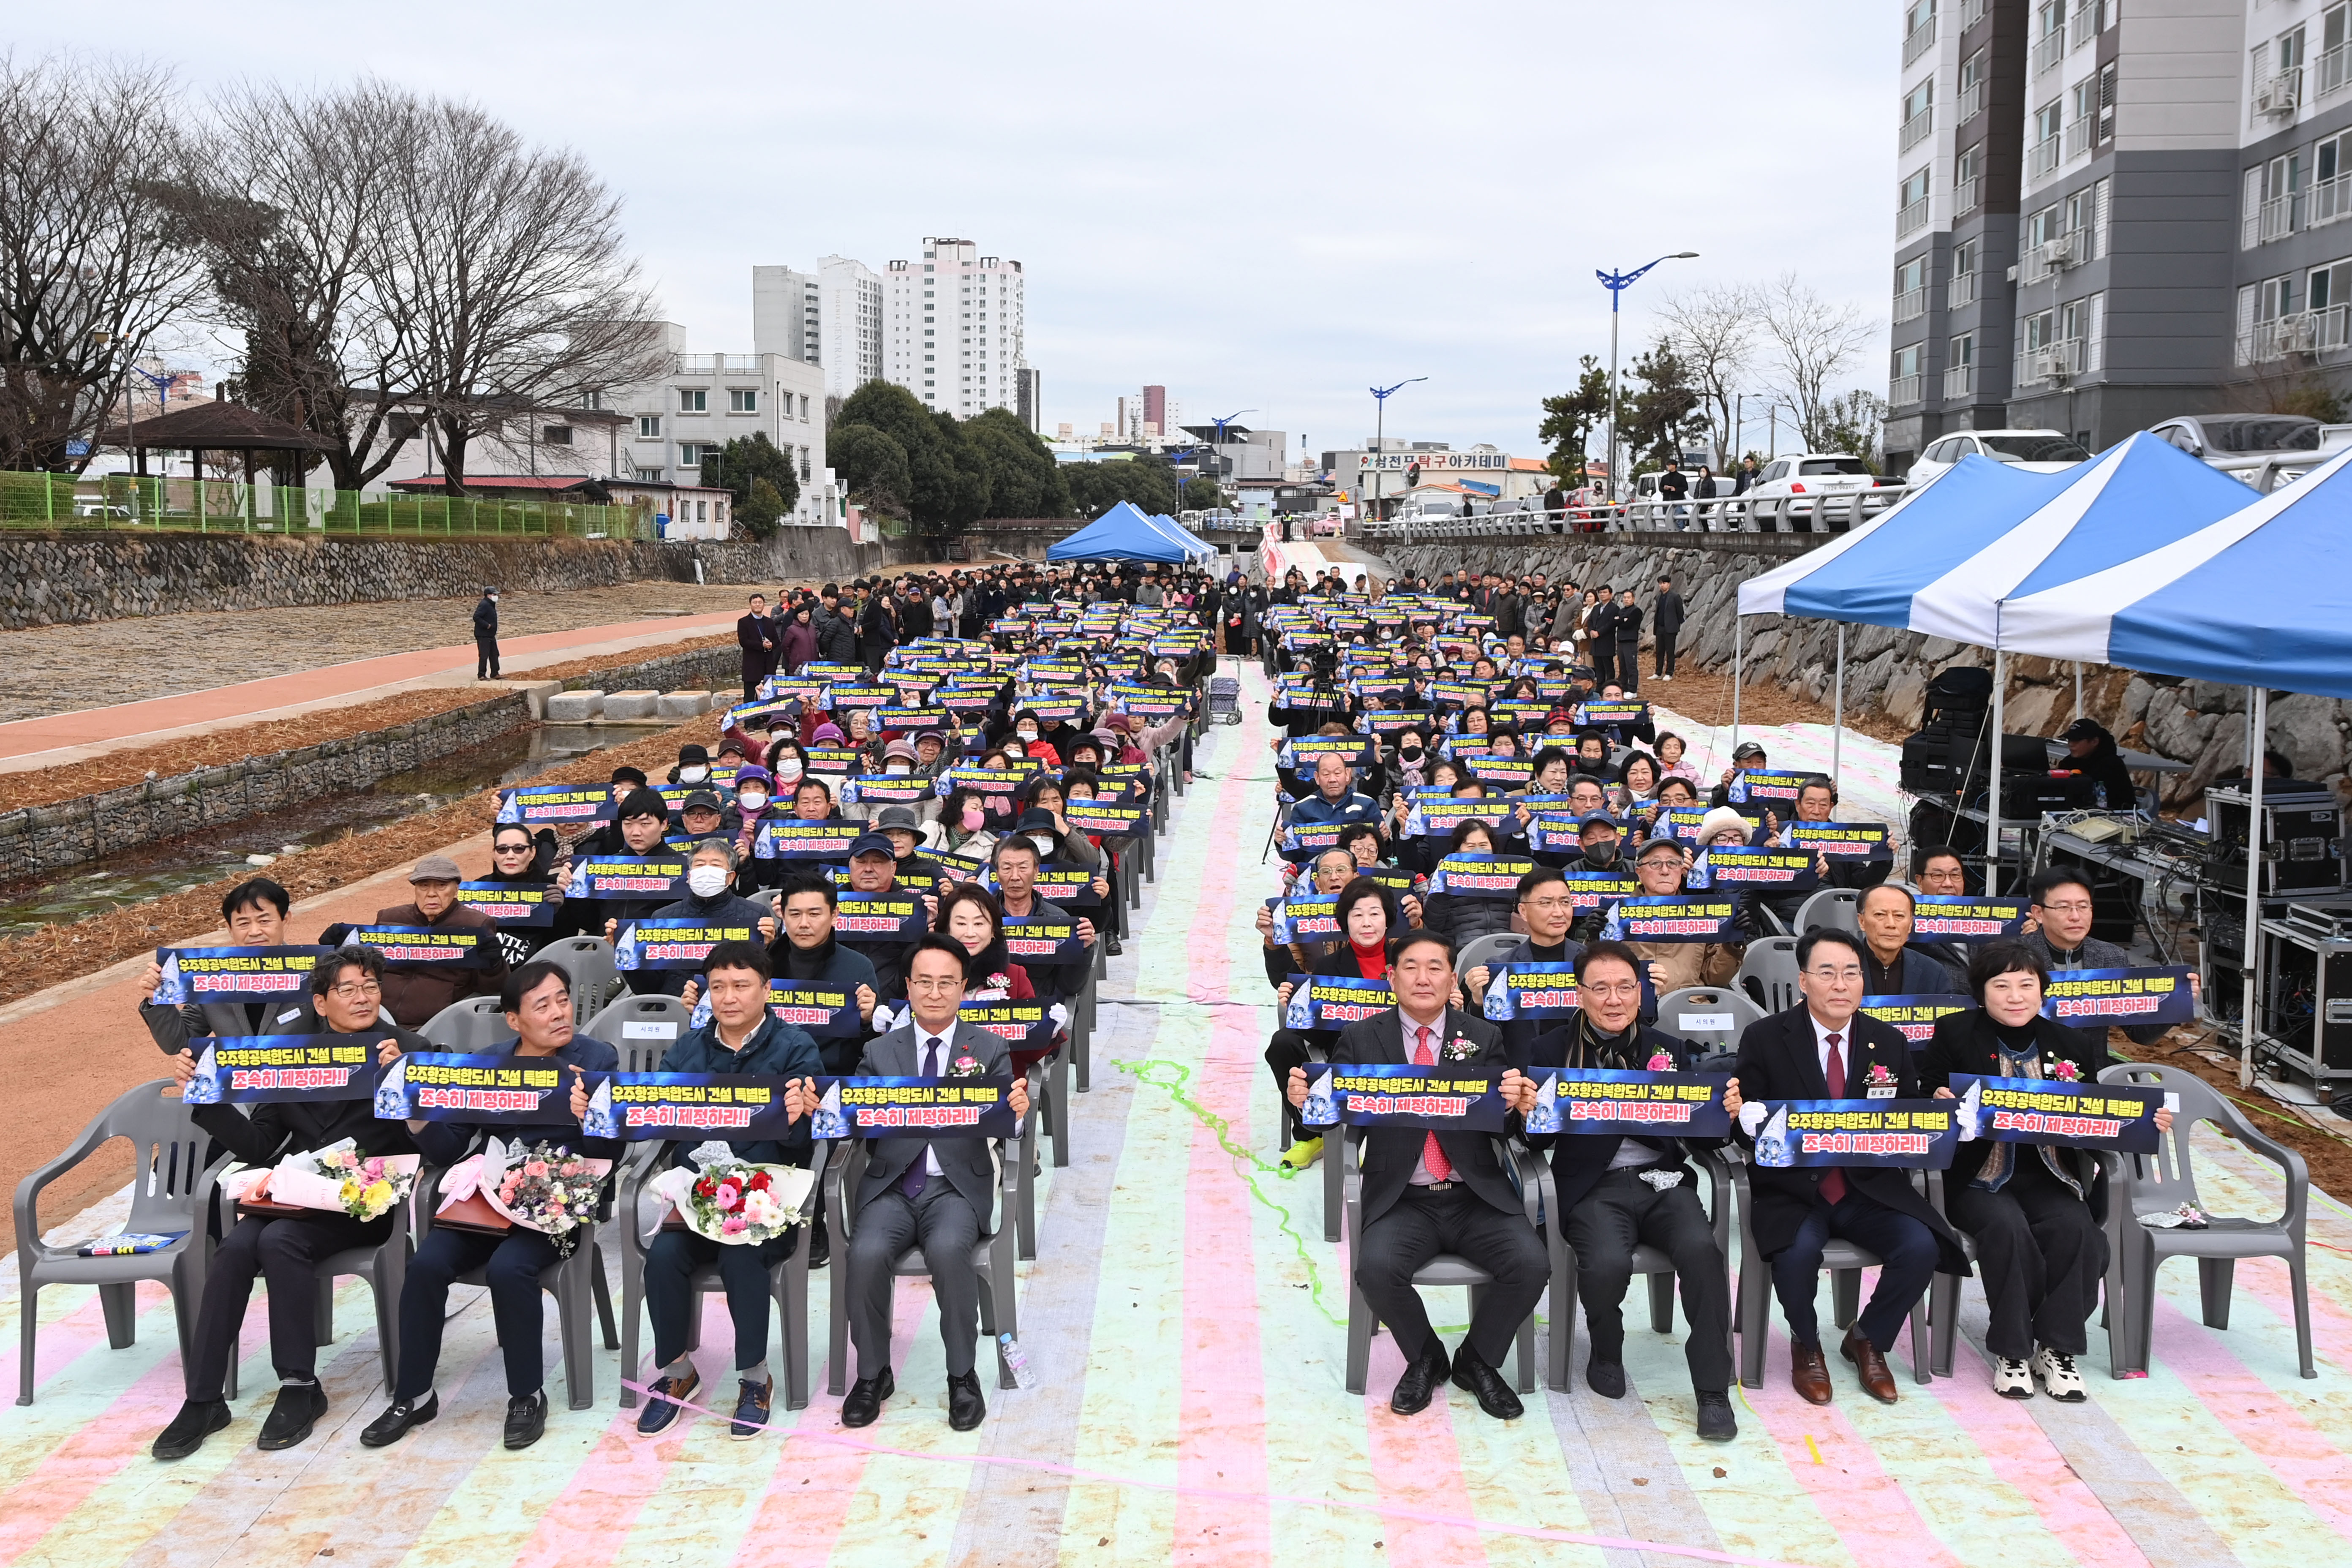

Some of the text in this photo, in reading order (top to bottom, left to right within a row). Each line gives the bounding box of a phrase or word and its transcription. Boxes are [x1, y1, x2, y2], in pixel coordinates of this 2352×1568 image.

[517, 791, 607, 806] 우주항공복합도시 건설 특별법
[527, 805, 595, 817] 조속히 제정하라!!
[772, 827, 860, 837] 우주항공복합도시 건설 특별법
[1792, 829, 1882, 841] 우주항공복합도시 건설 특별법
[780, 840, 848, 850] 조속히 제정하라!!
[1829, 843, 1870, 853] 제정하라!!
[1494, 863, 1509, 874] 건설
[1510, 863, 1532, 874] 특별법
[1709, 854, 1808, 868] 우주항공복합도시 건설 특별법
[587, 864, 682, 876] 우주항공복합도시 건설 특별법
[1718, 869, 1794, 880] 조속히 제정하라!!
[596, 879, 669, 890] 조속히 제정하라!!
[1448, 875, 1474, 887] 조속히
[457, 890, 543, 903] 항공복합도시 건설 특별법
[485, 905, 530, 916] 제정하라!!
[837, 901, 913, 915] 복합도시 건설 특별법
[1620, 904, 1731, 918] 우주항공복합도시 건설 특별법
[1914, 904, 2017, 919] 주항공복합도시 건설 특별법
[849, 918, 899, 930] 제정하라!!
[1632, 920, 1717, 933] 조속히 제정하라!!
[1916, 920, 2001, 933] 조속히 제정하라!!
[360, 932, 477, 945] 우주항공복합도시 건설 특별법
[636, 928, 749, 942] 우주항공복합도시 건설 특별법
[1026, 926, 1043, 937] 건설
[1045, 926, 1070, 938] 특별법
[496, 932, 530, 952] NTLE
[409, 948, 463, 959] 제정하라!!
[502, 948, 526, 964] AN
[647, 945, 681, 959] 조속히
[179, 956, 316, 972] 우주항공복합도시 건설 특별법
[194, 975, 299, 991] 조속히 제정하라!!
[1508, 973, 1578, 988] 우주항공복합도
[2045, 977, 2175, 997] 우주항공복합도시 건설 특별법
[795, 991, 814, 1005] 건설
[817, 992, 845, 1007] 특별법
[1311, 986, 1386, 1004] 우주항공복합도시
[1522, 992, 1560, 1007] 조속히
[991, 1008, 1010, 1021] 건설
[1012, 1007, 1042, 1021] 특별법
[1322, 1005, 1355, 1020] 조속히
[2058, 997, 2158, 1016] 조속히 제정하라!!
[217, 1046, 367, 1066] 우주항공복합도시 건설 특별법
[232, 1068, 348, 1088] 조속히 제정하라!!
[406, 1065, 558, 1087] 우주항공복합도시 건설 특별법
[1334, 1077, 1488, 1093] 우주항공복합도시 건설 특별법
[1557, 1082, 1712, 1101] 우주항공복합도시 건설 특별법
[420, 1089, 538, 1109] 조속히 제정하라!!
[612, 1086, 770, 1103] 우주항공복합도시 건설 특별법
[842, 1087, 998, 1104] 우주항공복합도시 건설 특별법
[1348, 1096, 1466, 1115] 조속히 제정하라!!
[1982, 1089, 2077, 1112] 우주항공복합도시
[2080, 1097, 2104, 1115] 건설
[2107, 1099, 2144, 1117] 특별법
[628, 1107, 749, 1126] 조속히 제정하라!!
[858, 1108, 978, 1126] 조속히 제정하라!!
[1571, 1102, 1690, 1121] 조속히 제정하라!!
[1788, 1112, 1949, 1130] 우주항공복합도시 건설 특별법
[1994, 1112, 2120, 1136] 조속히 제정하라!!
[1804, 1134, 1927, 1153] 조속히 제정하라!!
